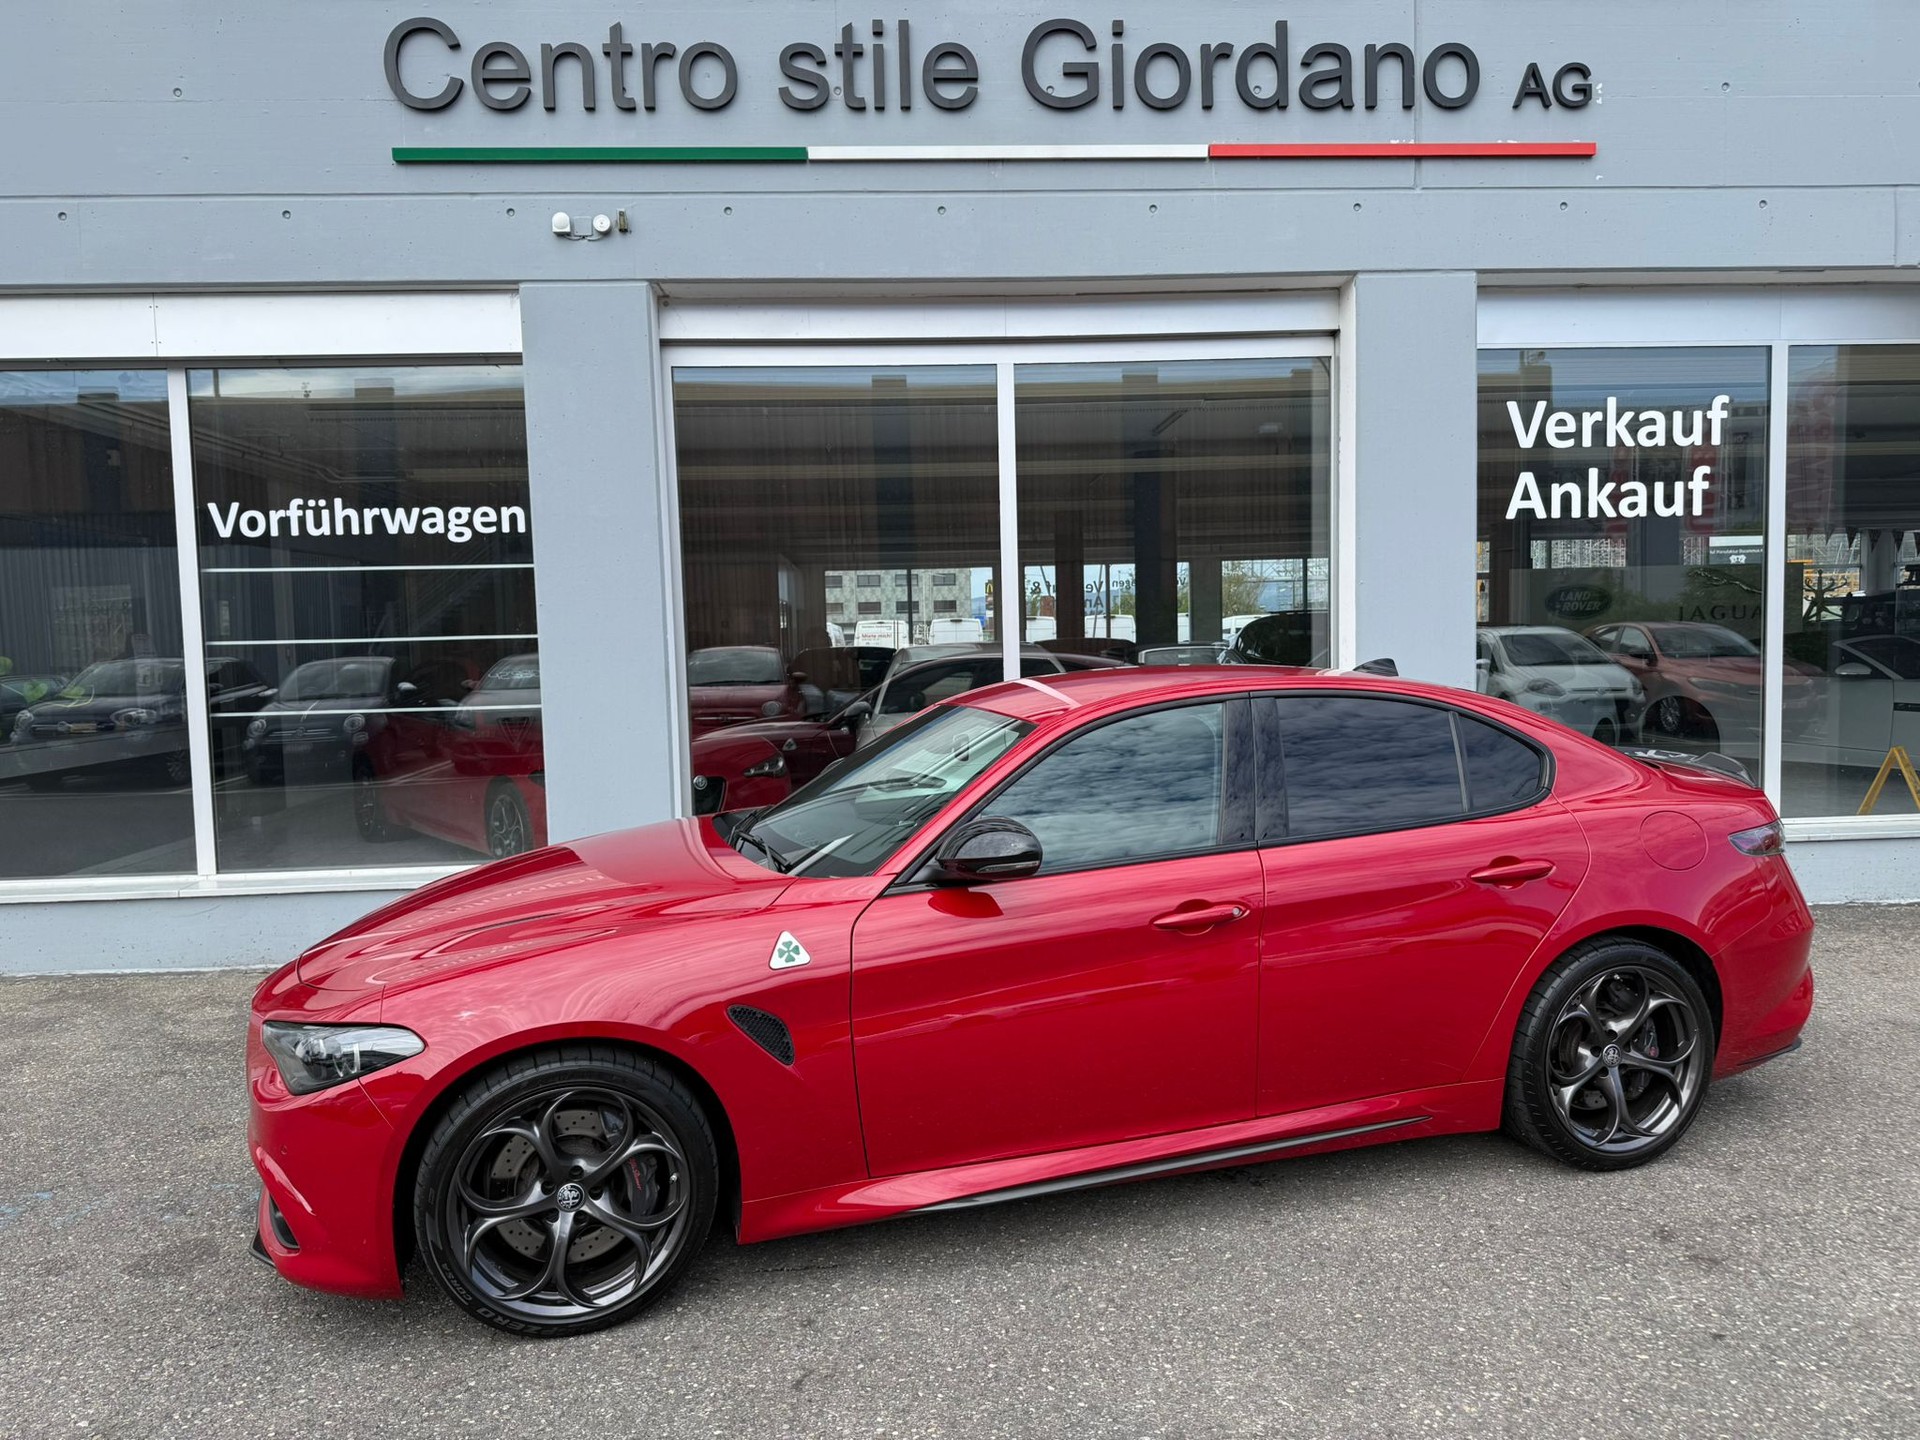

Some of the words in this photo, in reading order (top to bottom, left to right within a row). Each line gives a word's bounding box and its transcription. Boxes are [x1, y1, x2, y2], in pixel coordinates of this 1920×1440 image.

[384, 17, 737, 115] Centro
[779, 19, 979, 115] stile
[1022, 18, 1480, 114] Giordano
[1513, 62, 1592, 112] AG
[1506, 394, 1730, 449] Verkauf
[1505, 465, 1711, 520] Ankauf
[207, 497, 526, 543] Vorführwagen
[1559, 591, 1591, 602] LAND
[1561, 601, 1602, 612] ROVER
[1678, 604, 1763, 621] JAGUA
